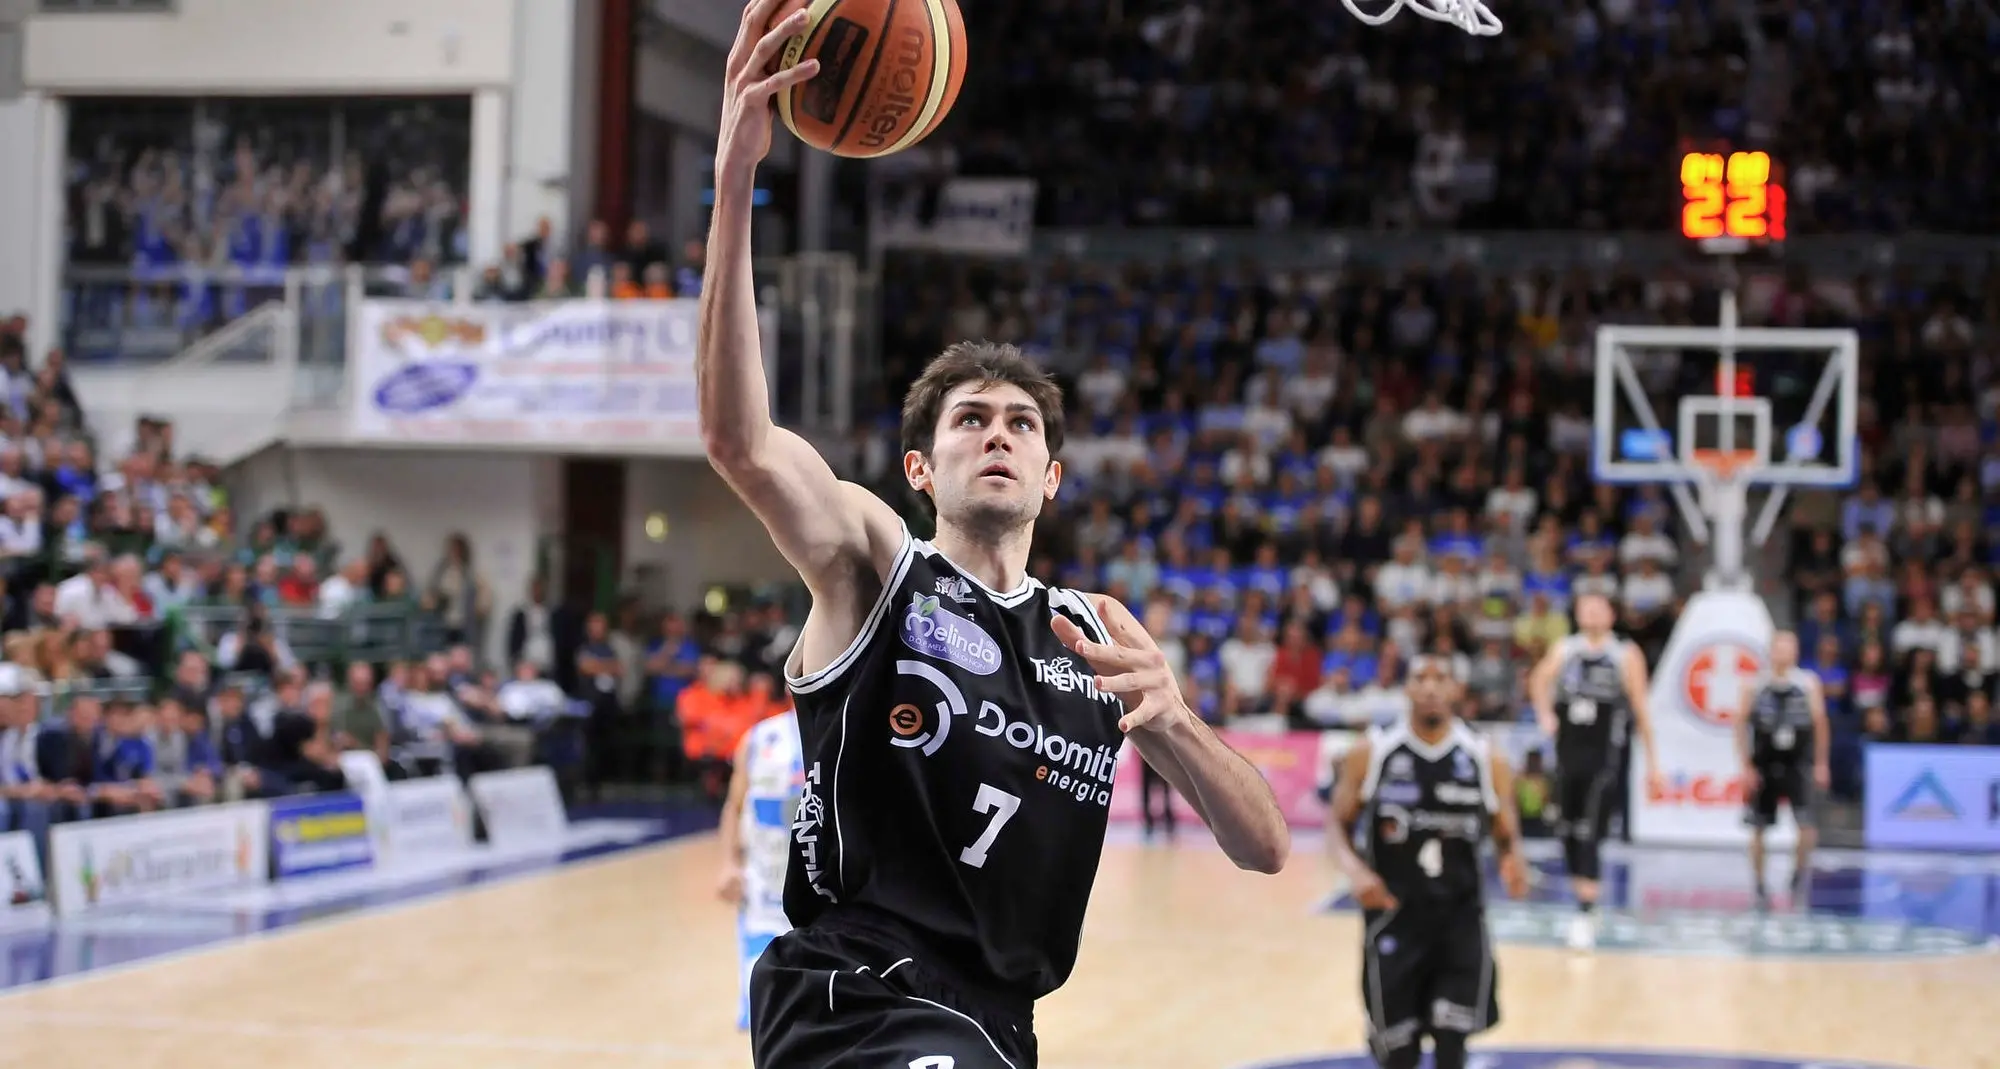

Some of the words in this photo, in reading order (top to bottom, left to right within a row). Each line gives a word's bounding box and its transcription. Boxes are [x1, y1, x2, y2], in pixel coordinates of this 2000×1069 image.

[858, 27, 926, 148] molten
[905, 611, 997, 665] Melinda
[1035, 765, 1110, 807] energia
[959, 782, 1022, 869] 7
[1418, 837, 1444, 879] 4
